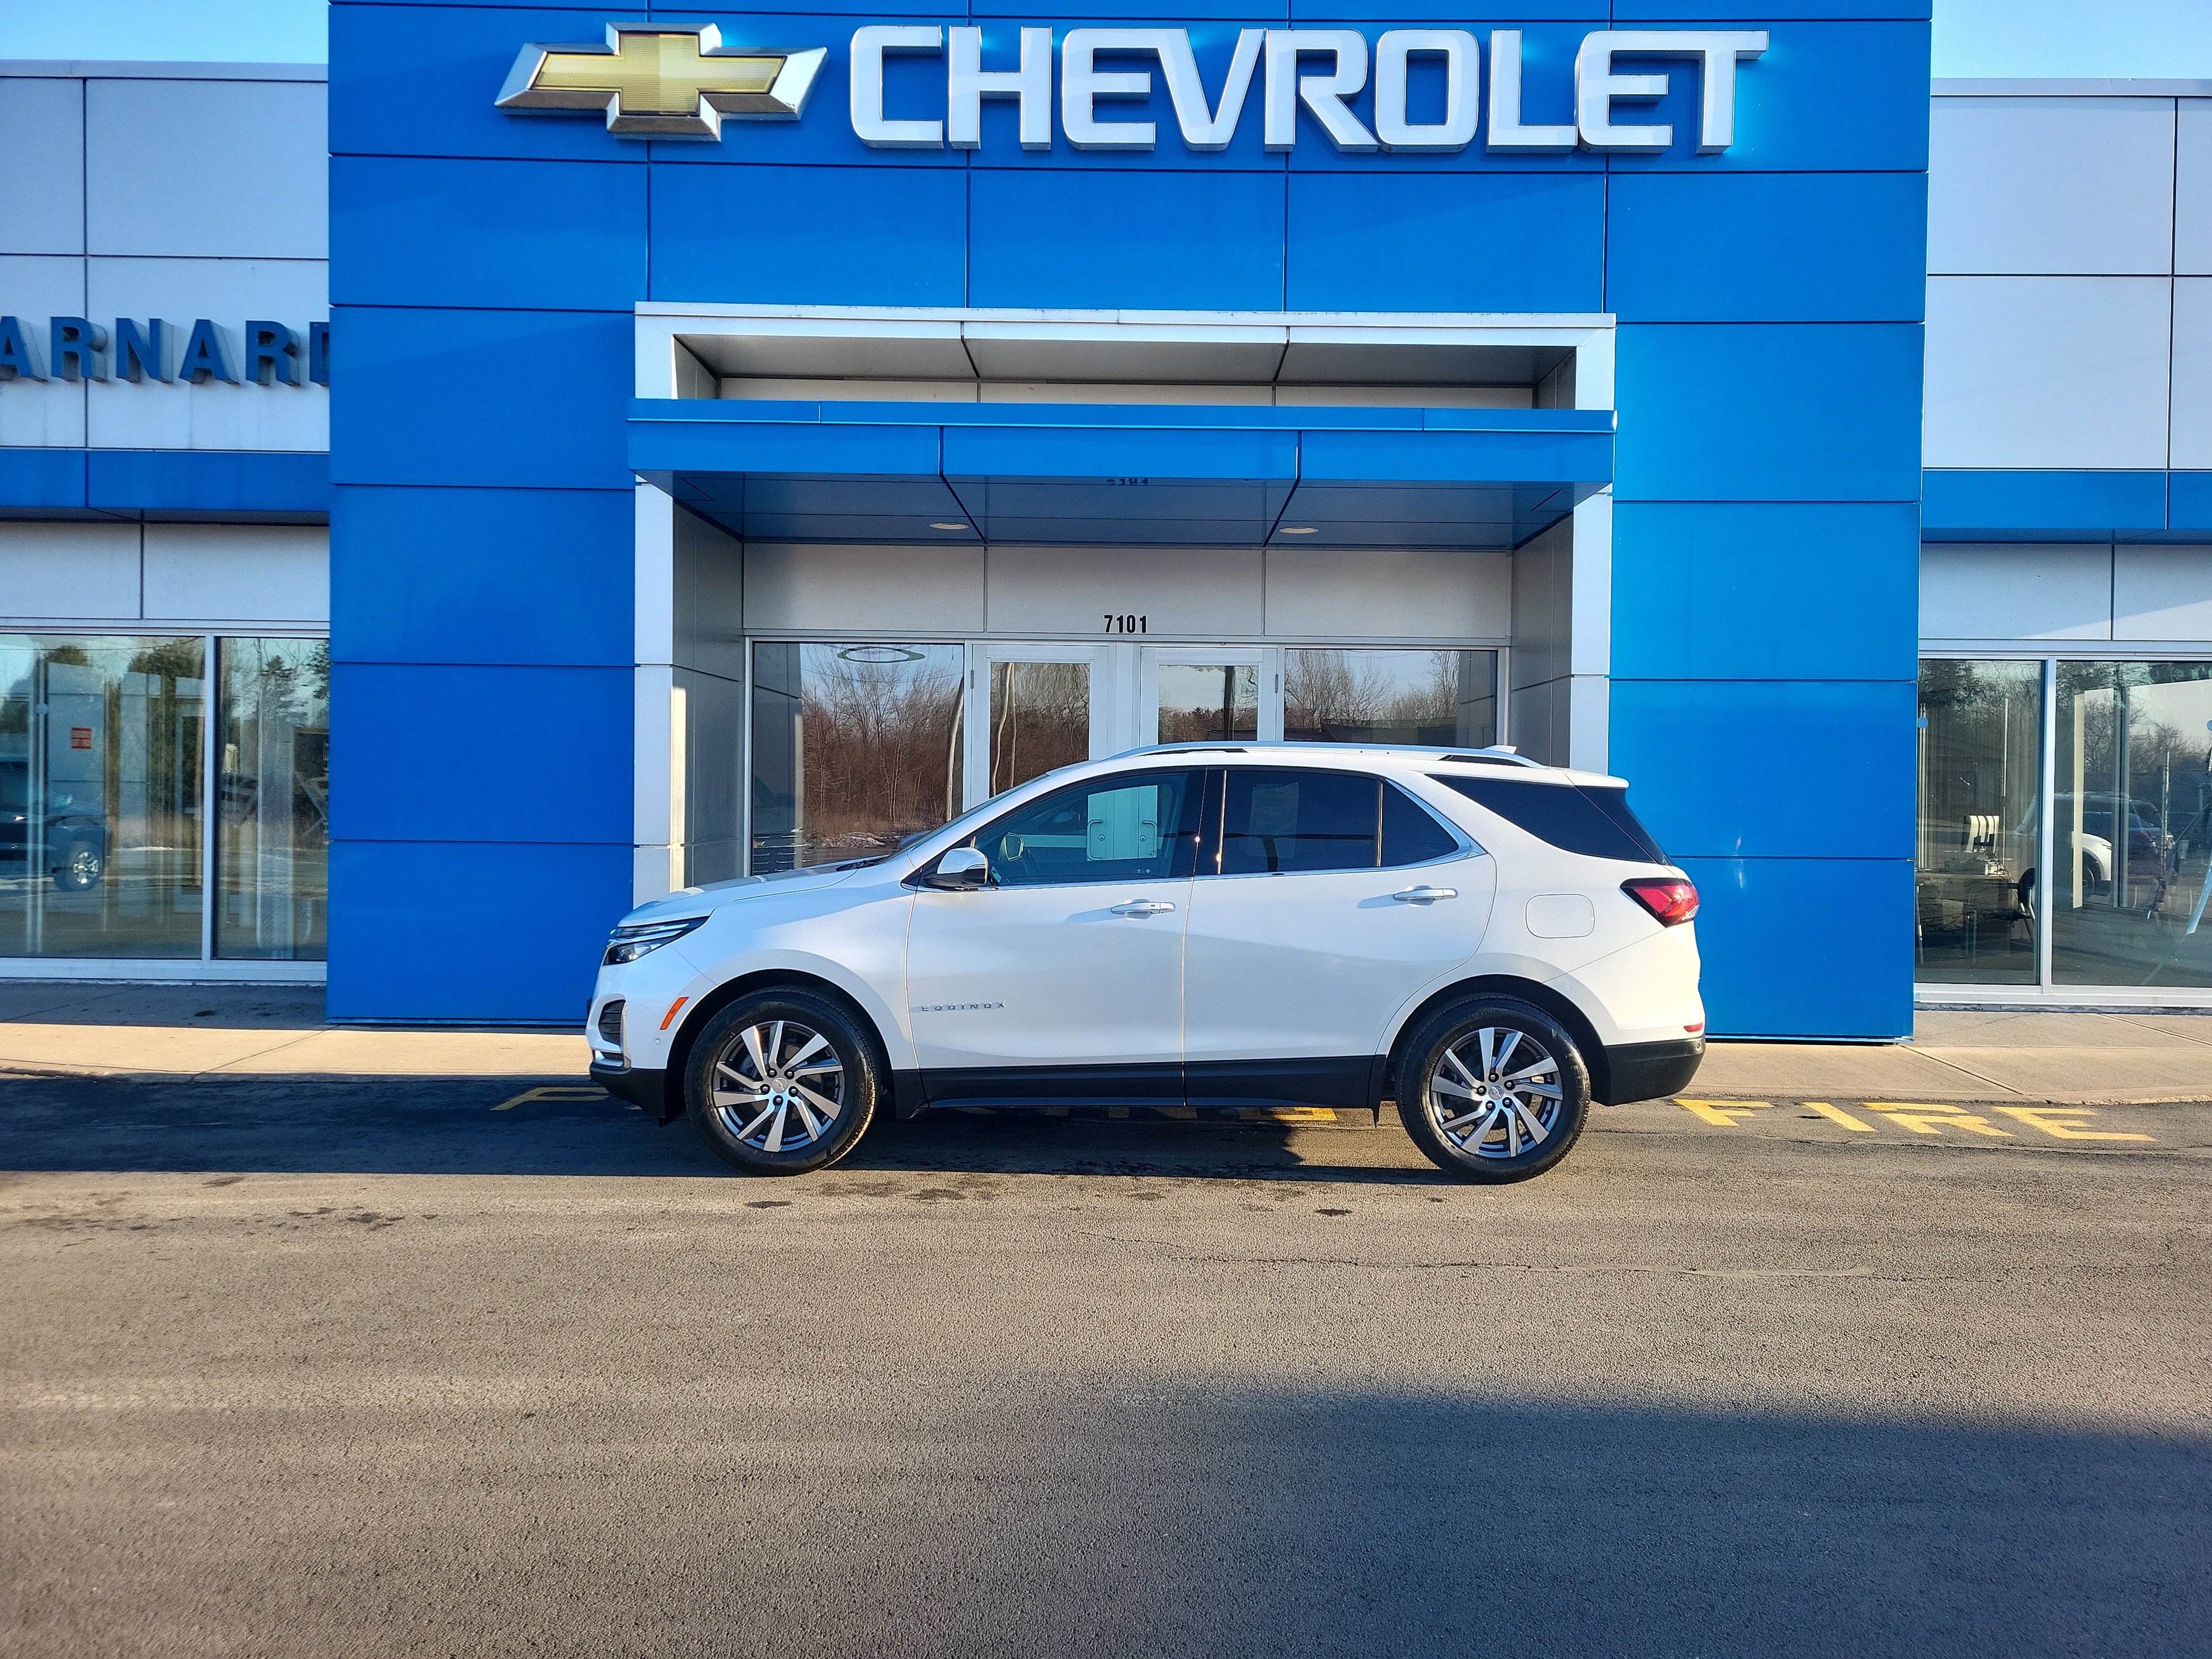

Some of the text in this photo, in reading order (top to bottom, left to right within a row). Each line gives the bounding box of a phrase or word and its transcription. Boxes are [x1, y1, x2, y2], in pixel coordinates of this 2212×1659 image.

[850, 24, 1768, 154] CHEVROLET
[1104, 614, 1146, 633] 7101
[922, 1001, 1006, 1011] EQUINOX
[1673, 1099, 2158, 1141] FIRE
